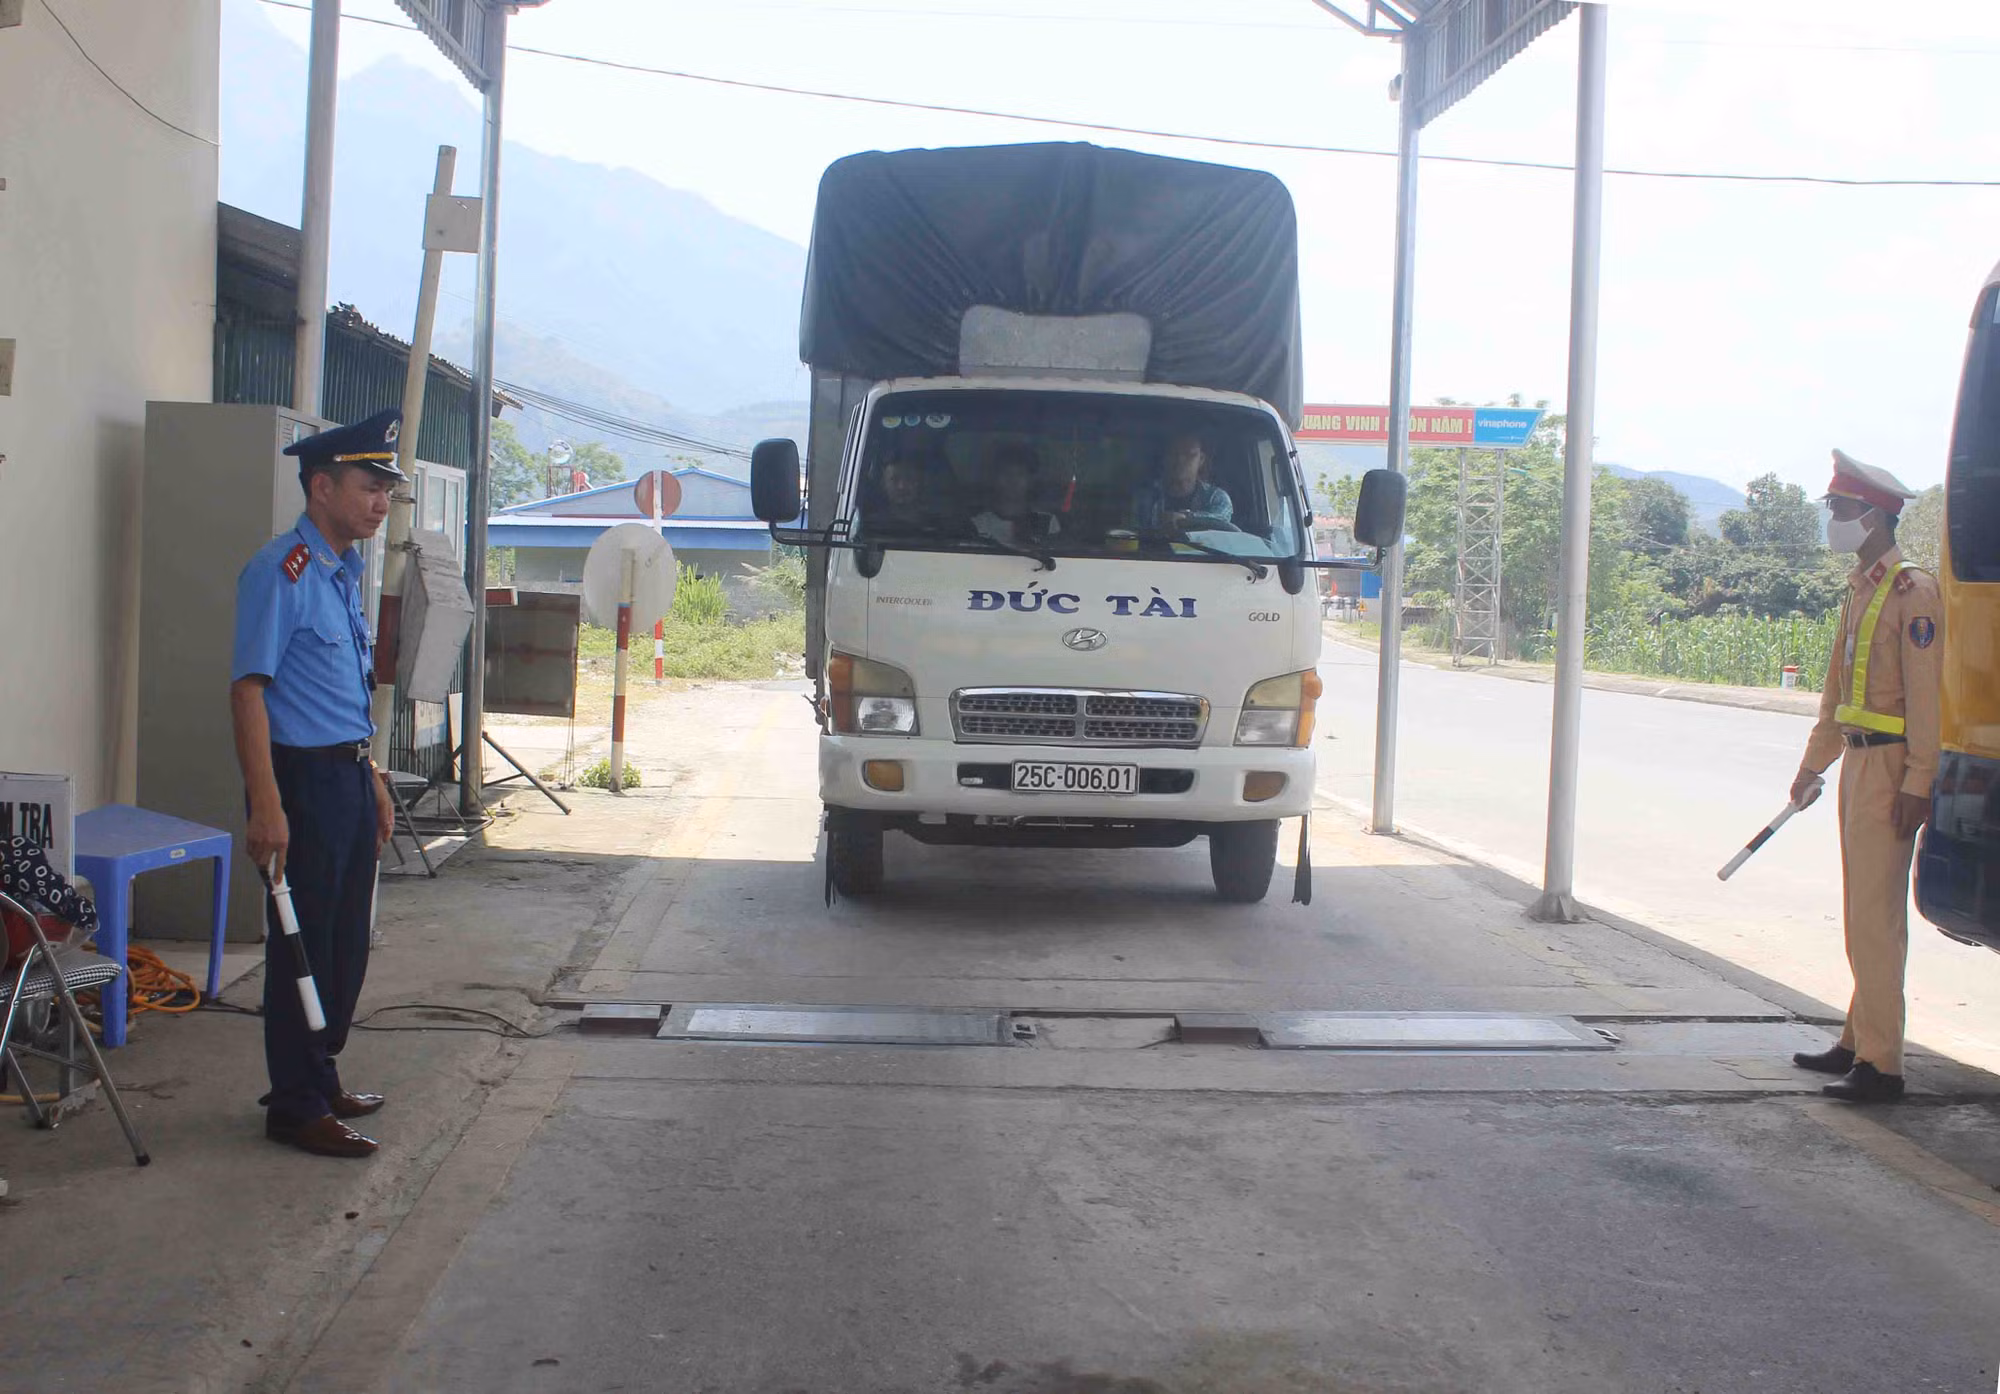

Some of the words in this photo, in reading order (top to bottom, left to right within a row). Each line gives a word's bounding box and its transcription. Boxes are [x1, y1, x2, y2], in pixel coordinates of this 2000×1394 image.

[1299, 414, 1342, 431] UANG
[1345, 415, 1380, 432] VINH
[967, 581, 1080, 614] ĐỨC
[1105, 586, 1198, 618] TÀI
[1248, 612, 1280, 622] GOLD
[1017, 765, 1131, 791] 25C-006.01
[19, 802, 54, 850] TRA
